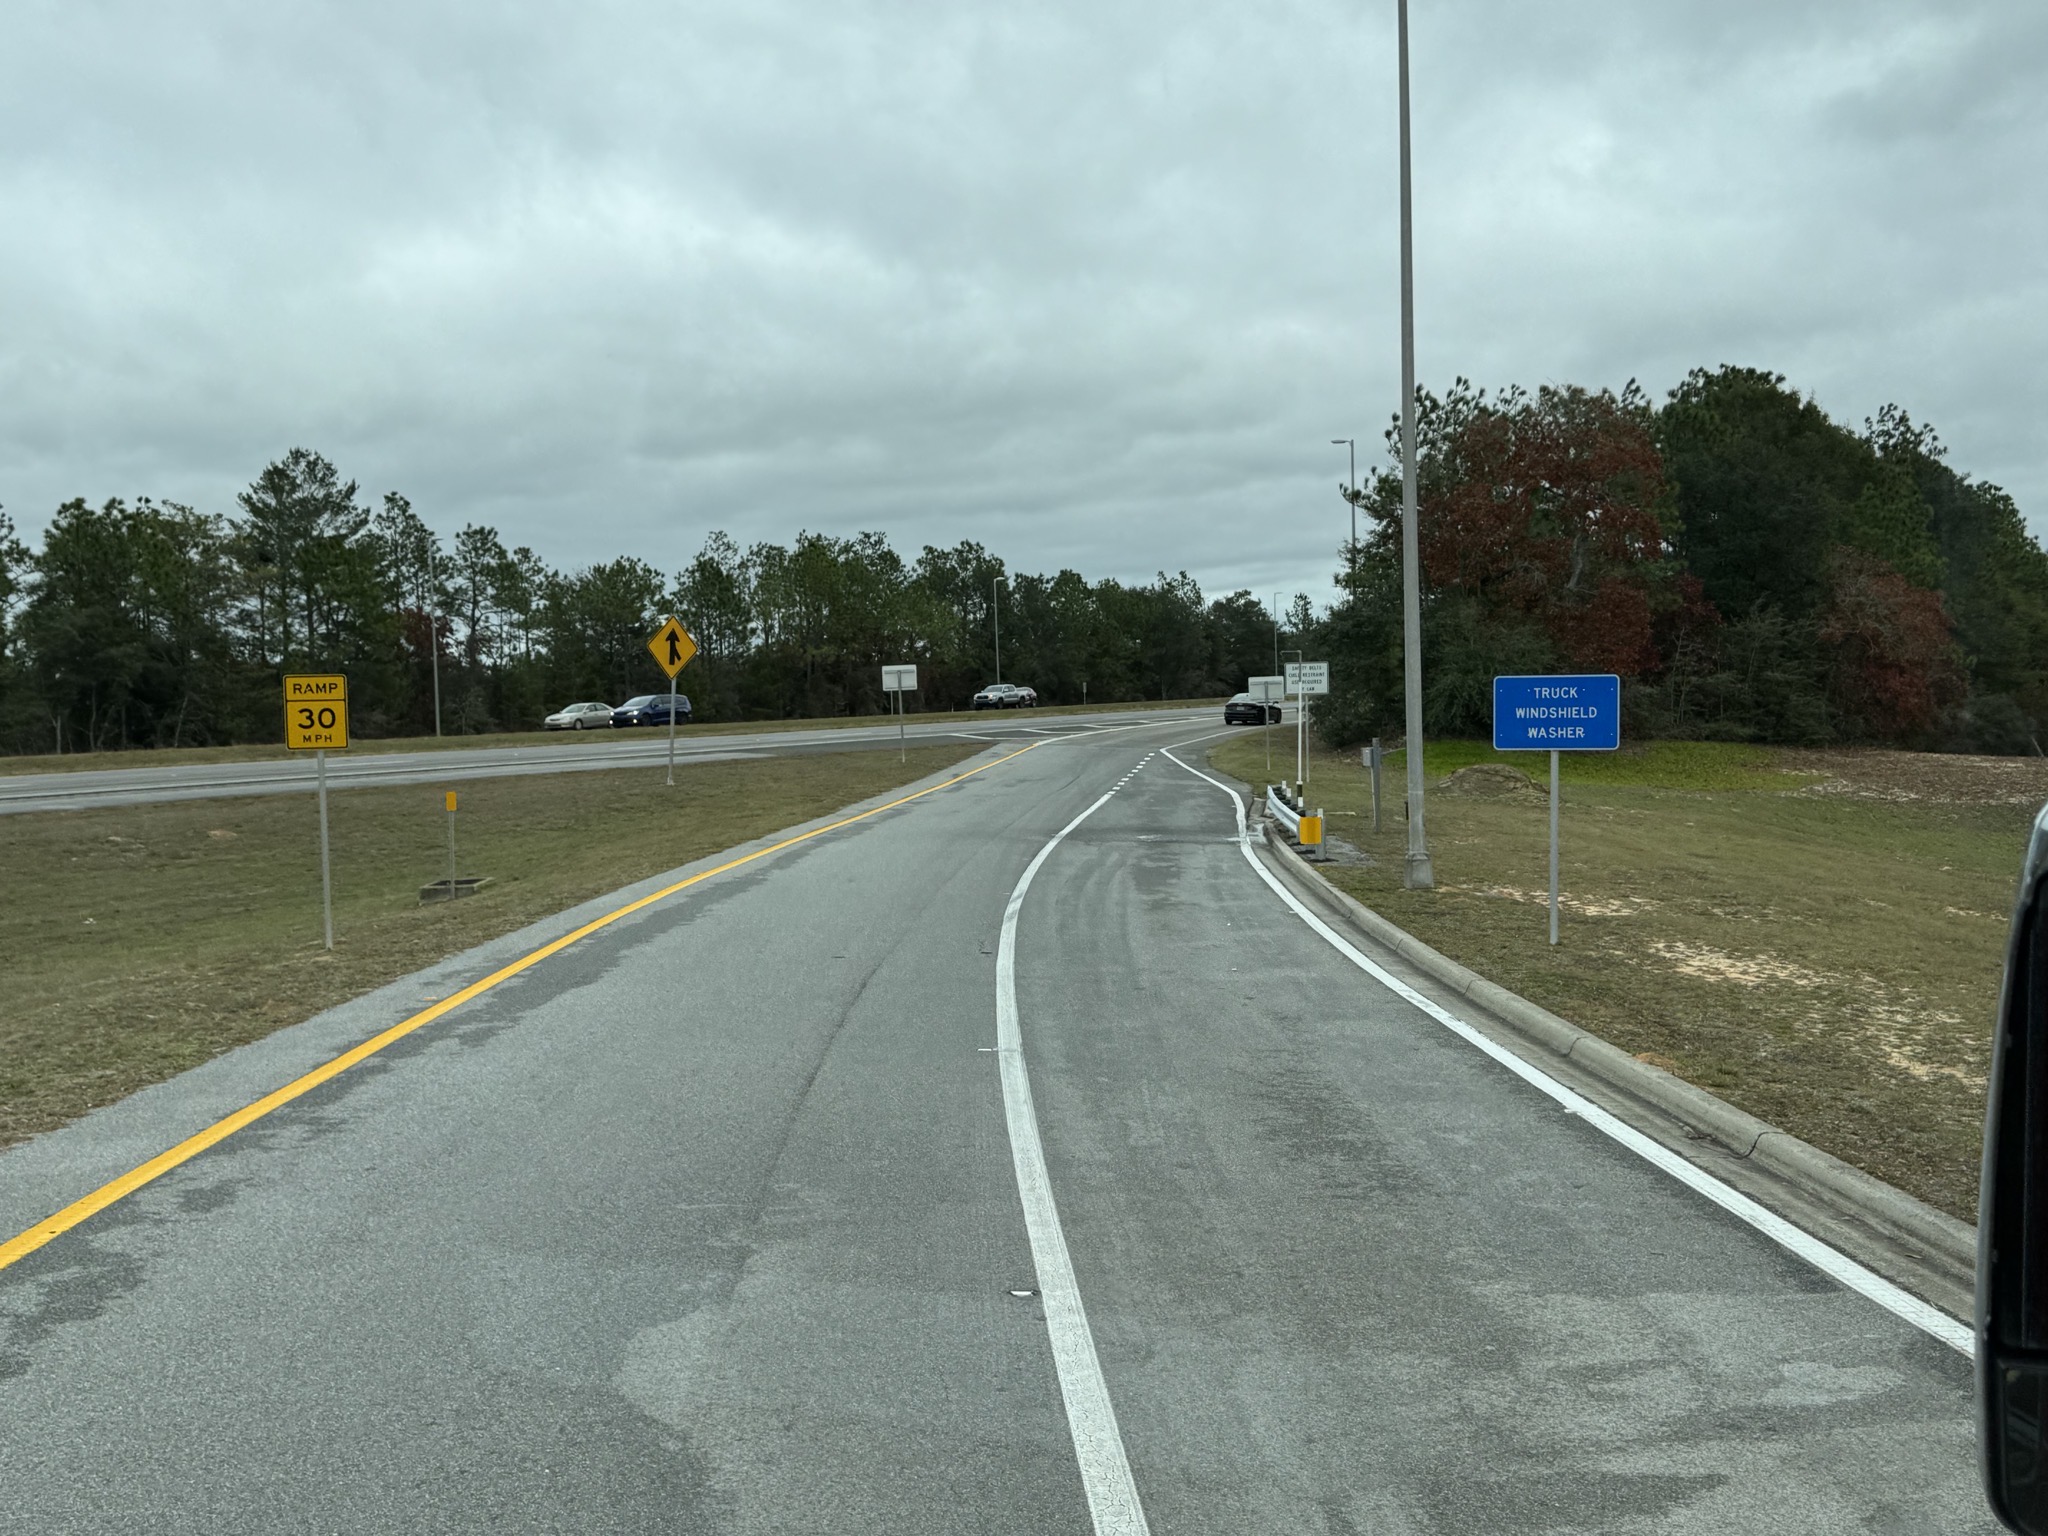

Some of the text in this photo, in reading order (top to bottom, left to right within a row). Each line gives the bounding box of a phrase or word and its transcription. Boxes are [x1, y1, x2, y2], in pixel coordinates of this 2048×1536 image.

[293, 683, 338, 694] RAMP
[1533, 687, 1578, 699] TRUCK
[298, 707, 336, 729] 30
[1515, 707, 1598, 719] WINDSHIELD
[303, 734, 332, 743] MPH
[1528, 727, 1584, 739] WASHER
